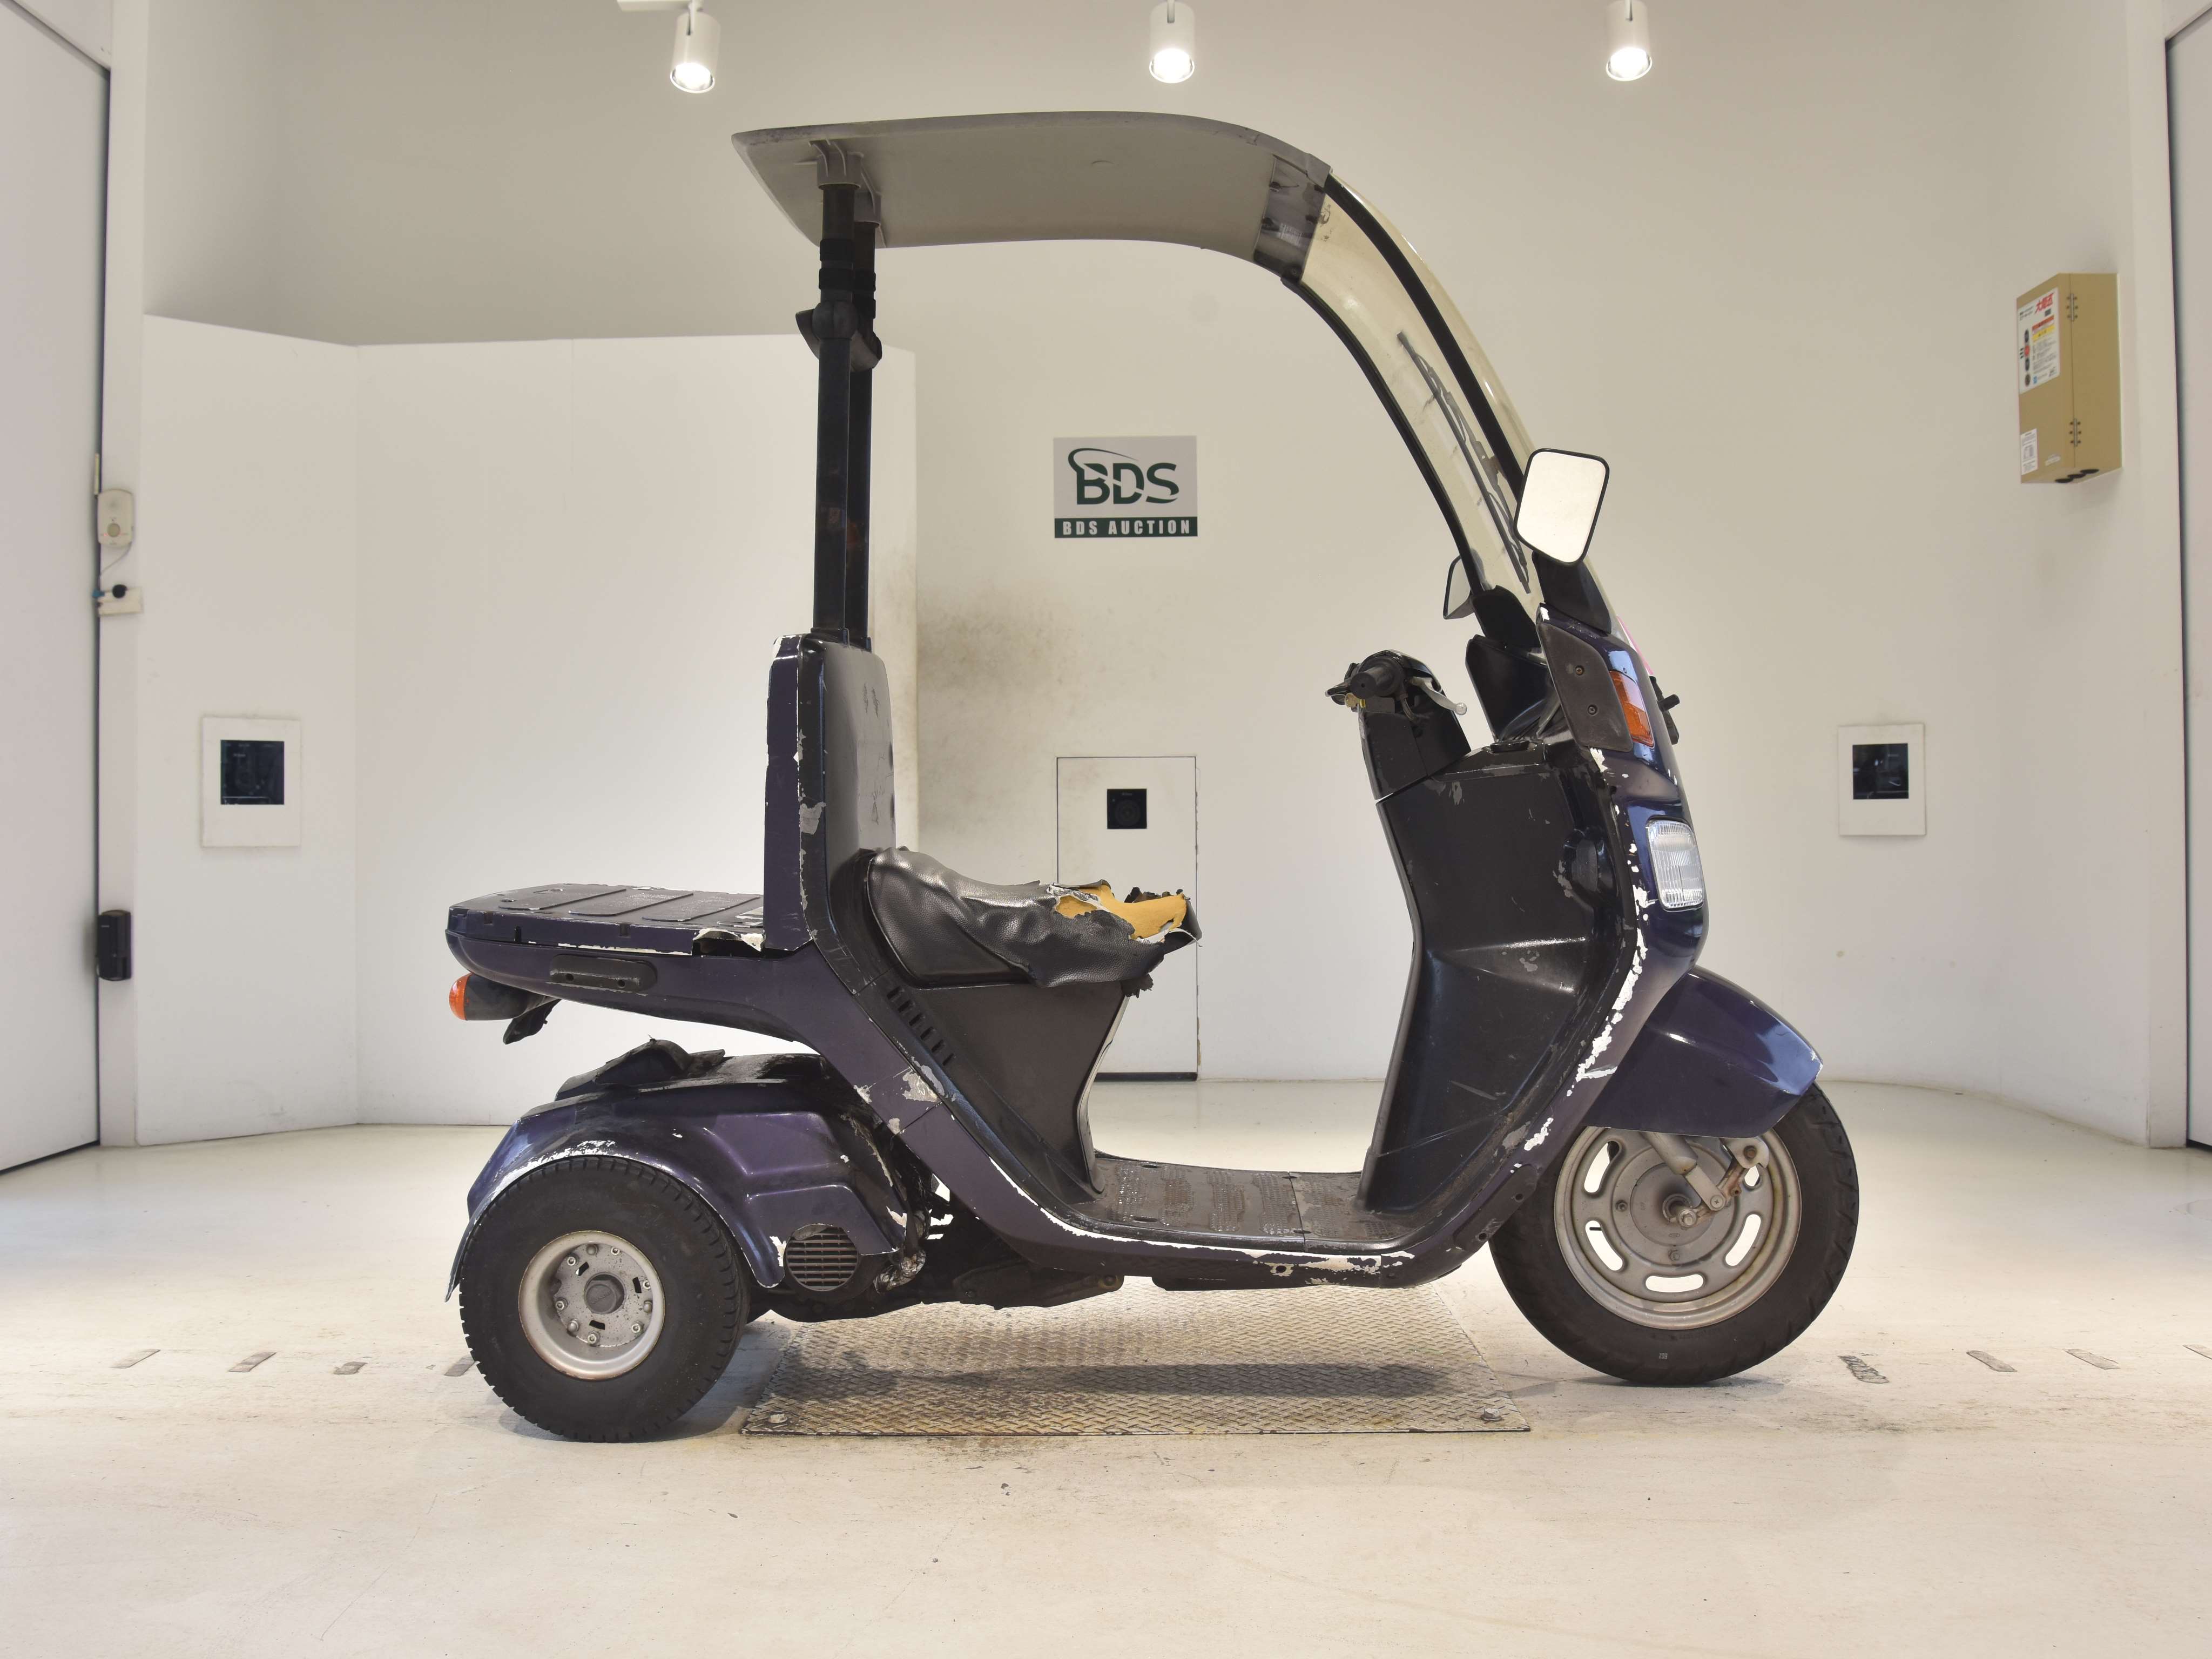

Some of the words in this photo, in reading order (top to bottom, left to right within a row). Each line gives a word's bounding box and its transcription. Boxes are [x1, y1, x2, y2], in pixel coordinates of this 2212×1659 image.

[1068, 448, 1179, 505] BDS
[1062, 521, 1098, 536] BDS
[1108, 520, 1190, 535] AUCTION
